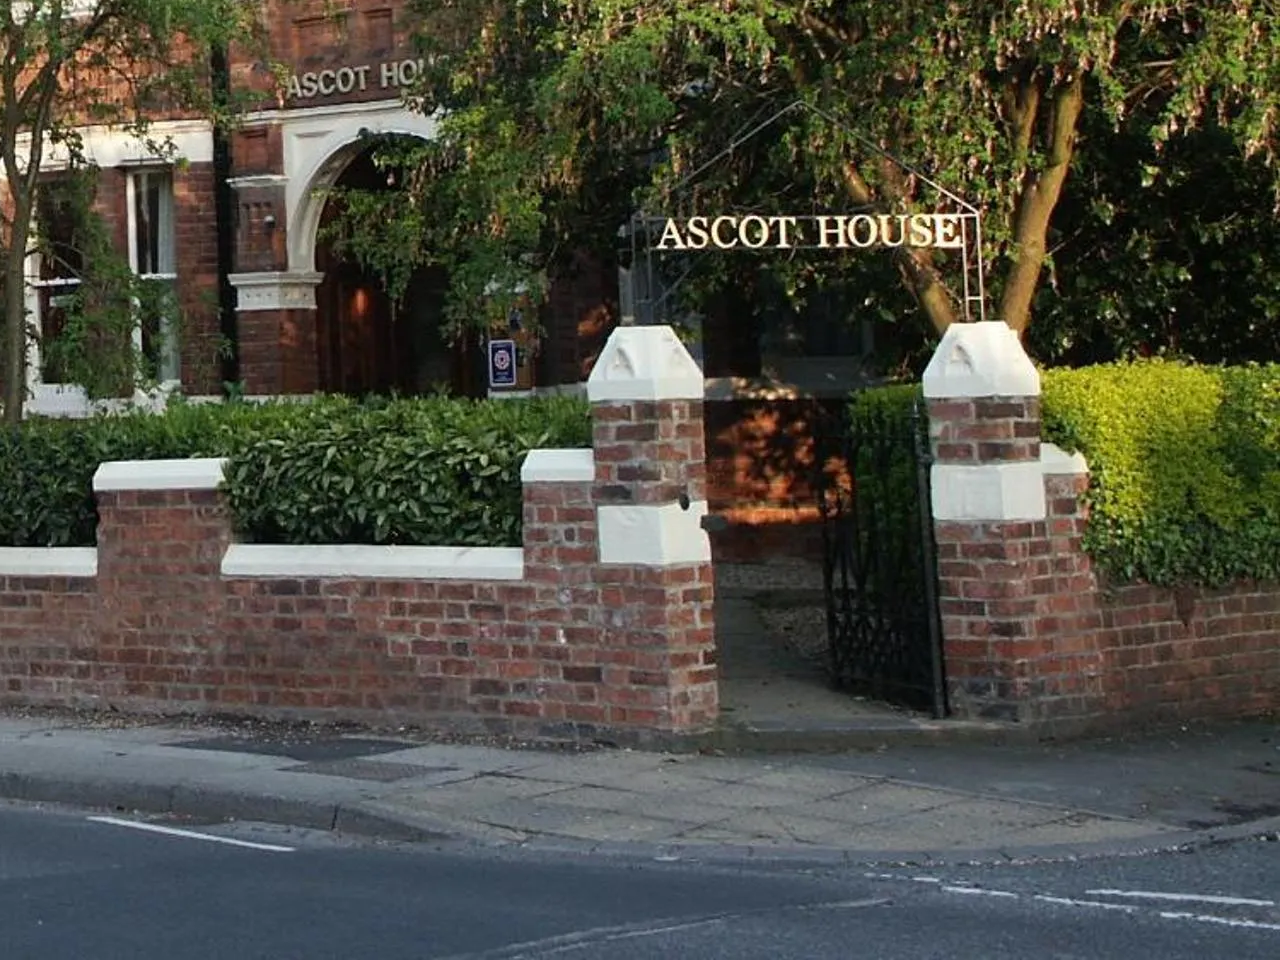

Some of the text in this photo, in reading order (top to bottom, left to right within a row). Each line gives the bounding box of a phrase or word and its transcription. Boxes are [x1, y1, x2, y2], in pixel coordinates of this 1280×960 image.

[286, 64, 370, 100] ASCOT
[657, 213, 963, 250] ASCOT HOUSE
